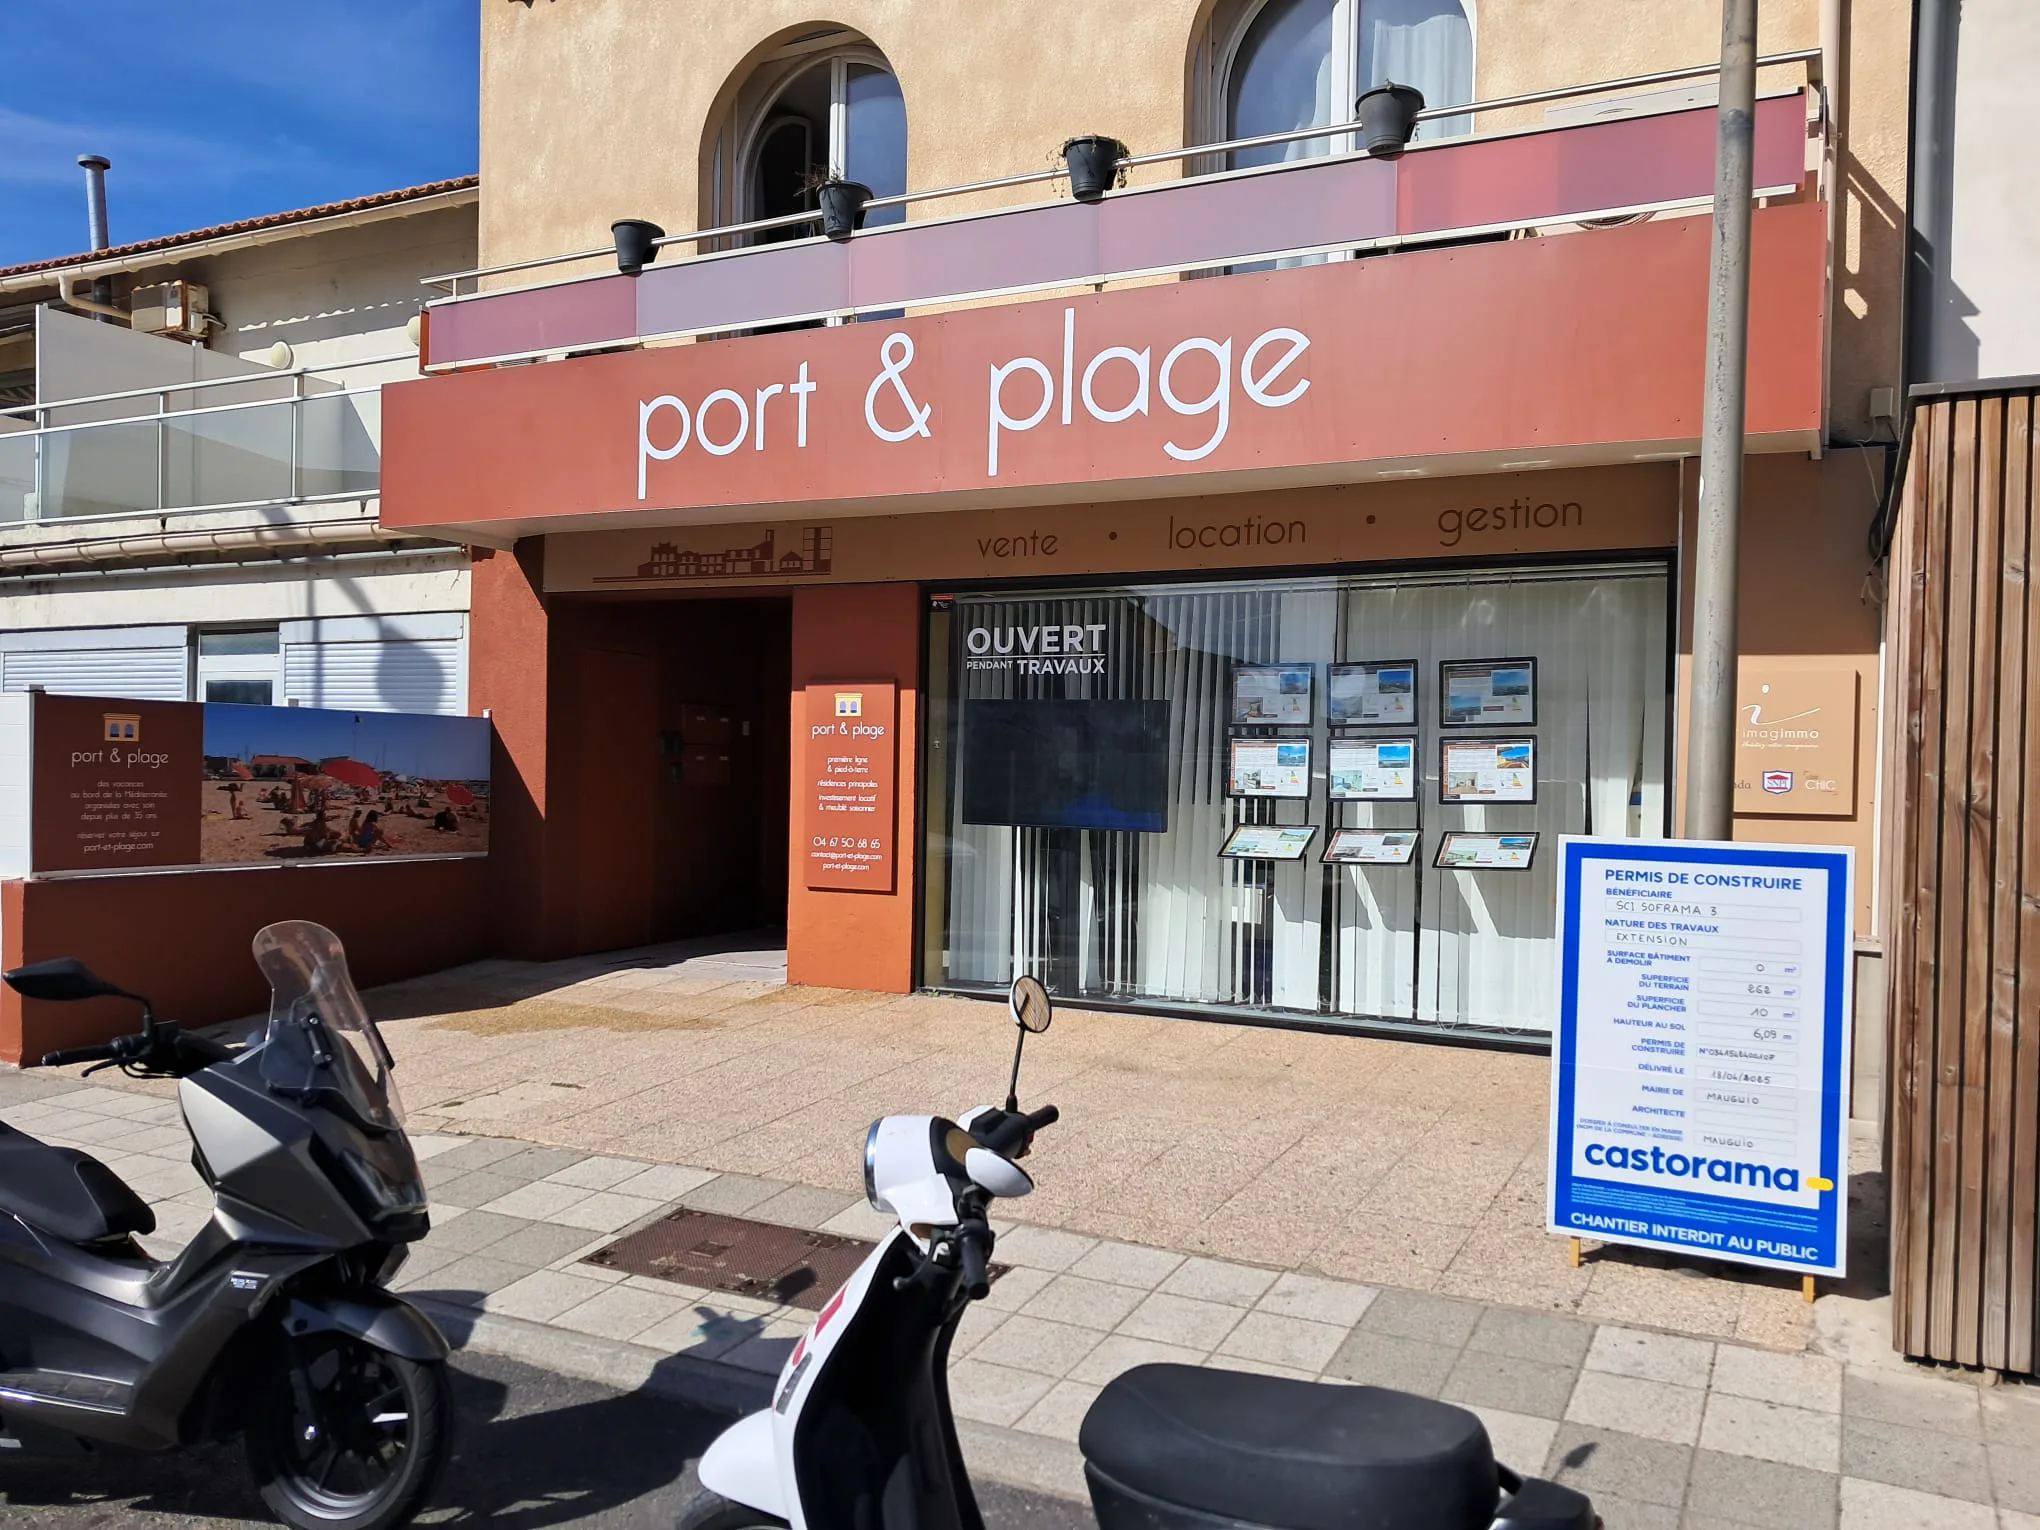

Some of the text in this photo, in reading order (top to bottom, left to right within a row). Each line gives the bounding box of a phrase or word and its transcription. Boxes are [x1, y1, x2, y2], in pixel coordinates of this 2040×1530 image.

[638, 307, 1312, 500] port & plage
[1437, 496, 1583, 547] gestion
[1168, 515, 1307, 550] location
[977, 530, 1059, 559] vente
[966, 624, 1106, 654] OUVERT
[966, 658, 1105, 675] PENDANT TRAVAUX
[811, 721, 885, 740] port & plage
[71, 747, 169, 769] port & plage
[83, 841, 154, 854] port-et-plage.com
[813, 836, 881, 849] 04 67 50 68 65
[822, 861, 870, 873] port-et-plage.com
[1605, 869, 1803, 890] PERMIS DE CONSTRUIRE
[1605, 886, 1673, 899] BÉNÉFICIAIRE
[1616, 900, 1718, 916] SCI SOFRAMA 3
[1605, 918, 1719, 933] NATURE DES TRAVAUX
[1616, 932, 1688, 946] EXTENSION
[1607, 949, 1691, 962] SURFACE BÂTIMENT
[1641, 973, 1690, 984] SUPERFICIE
[1638, 980, 1690, 991] DU TERRAIN
[1636, 994, 1685, 1005] SUPERFICIE
[1627, 1001, 1687, 1013] DU PLANCHER
[1613, 1017, 1687, 1031] HAUTEUR AU SOL
[1753, 1028, 1777, 1040] 6,09
[1631, 1044, 1686, 1056] CONSTRUIRE
[1641, 1038, 1686, 1049] PERMIS DE
[1638, 1062, 1685, 1075] DÉLIVRÉ LE
[1641, 1084, 1684, 1096] MAIRIE DE
[1706, 1092, 1760, 1105] MAUGUIO
[1632, 1105, 1686, 1118] ARCHITECTE
[1613, 1121, 1651, 1131] CONSULTER
[1703, 1135, 1754, 1149] MAUGUIO
[1585, 1142, 1799, 1192] castorama
[1570, 1211, 1819, 1261] CHANTIER INTERDIT AU PUBLIC
